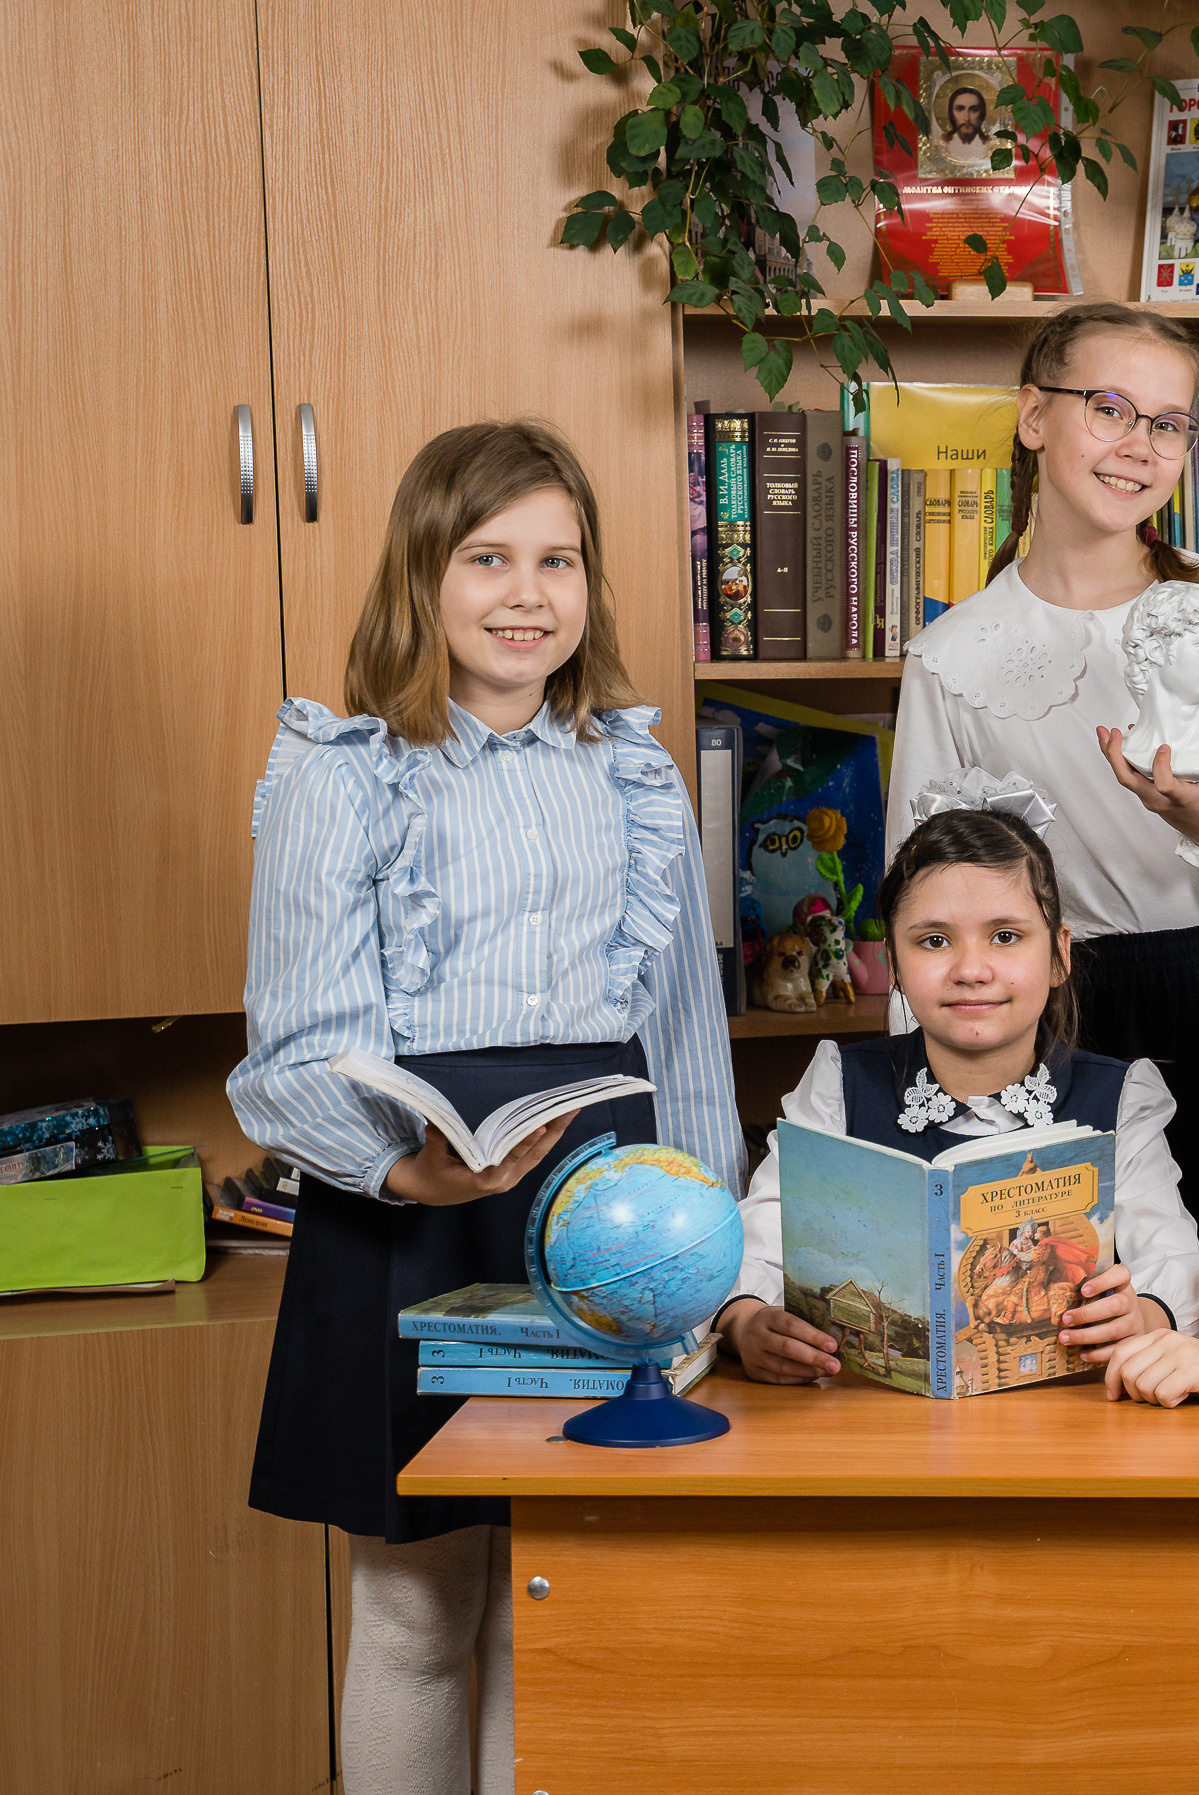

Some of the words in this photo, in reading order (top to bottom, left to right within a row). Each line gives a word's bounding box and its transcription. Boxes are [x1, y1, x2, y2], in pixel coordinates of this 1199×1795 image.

[937, 446, 987, 460] Наши
[824, 476, 835, 523] ЯЗЫКА
[848, 449, 858, 528] ПОСЛОВИЦЫ
[890, 467, 900, 505] СЛОВА
[812, 470, 823, 532] СЛОВАРЬ
[925, 498, 950, 507] СЛОВАРЬ
[957, 499, 978, 508] СЛОВАРЬ
[983, 489, 994, 525] СЛОВАРЬ
[812, 537, 823, 603] УЧЕБНЫЙ
[824, 526, 836, 600] РУССКОГО
[848, 531, 858, 594] РУССКОГО
[711, 738, 722, 746] 80
[934, 1183, 944, 1197] 3
[981, 1173, 1081, 1205] ХРЕСТОМАТИЯ
[990, 1204, 1004, 1213] ПО
[1012, 1190, 1073, 1208] ЛИТЕРАТУРЕ
[1015, 1210, 1021, 1218] 3
[412, 1321, 501, 1336] ХРЕСТОМАТИЯ.
[432, 1349, 445, 1358] 3
[935, 1309, 946, 1392] ХРЕСТОМАТИЯ.
[431, 1376, 445, 1384] 3
